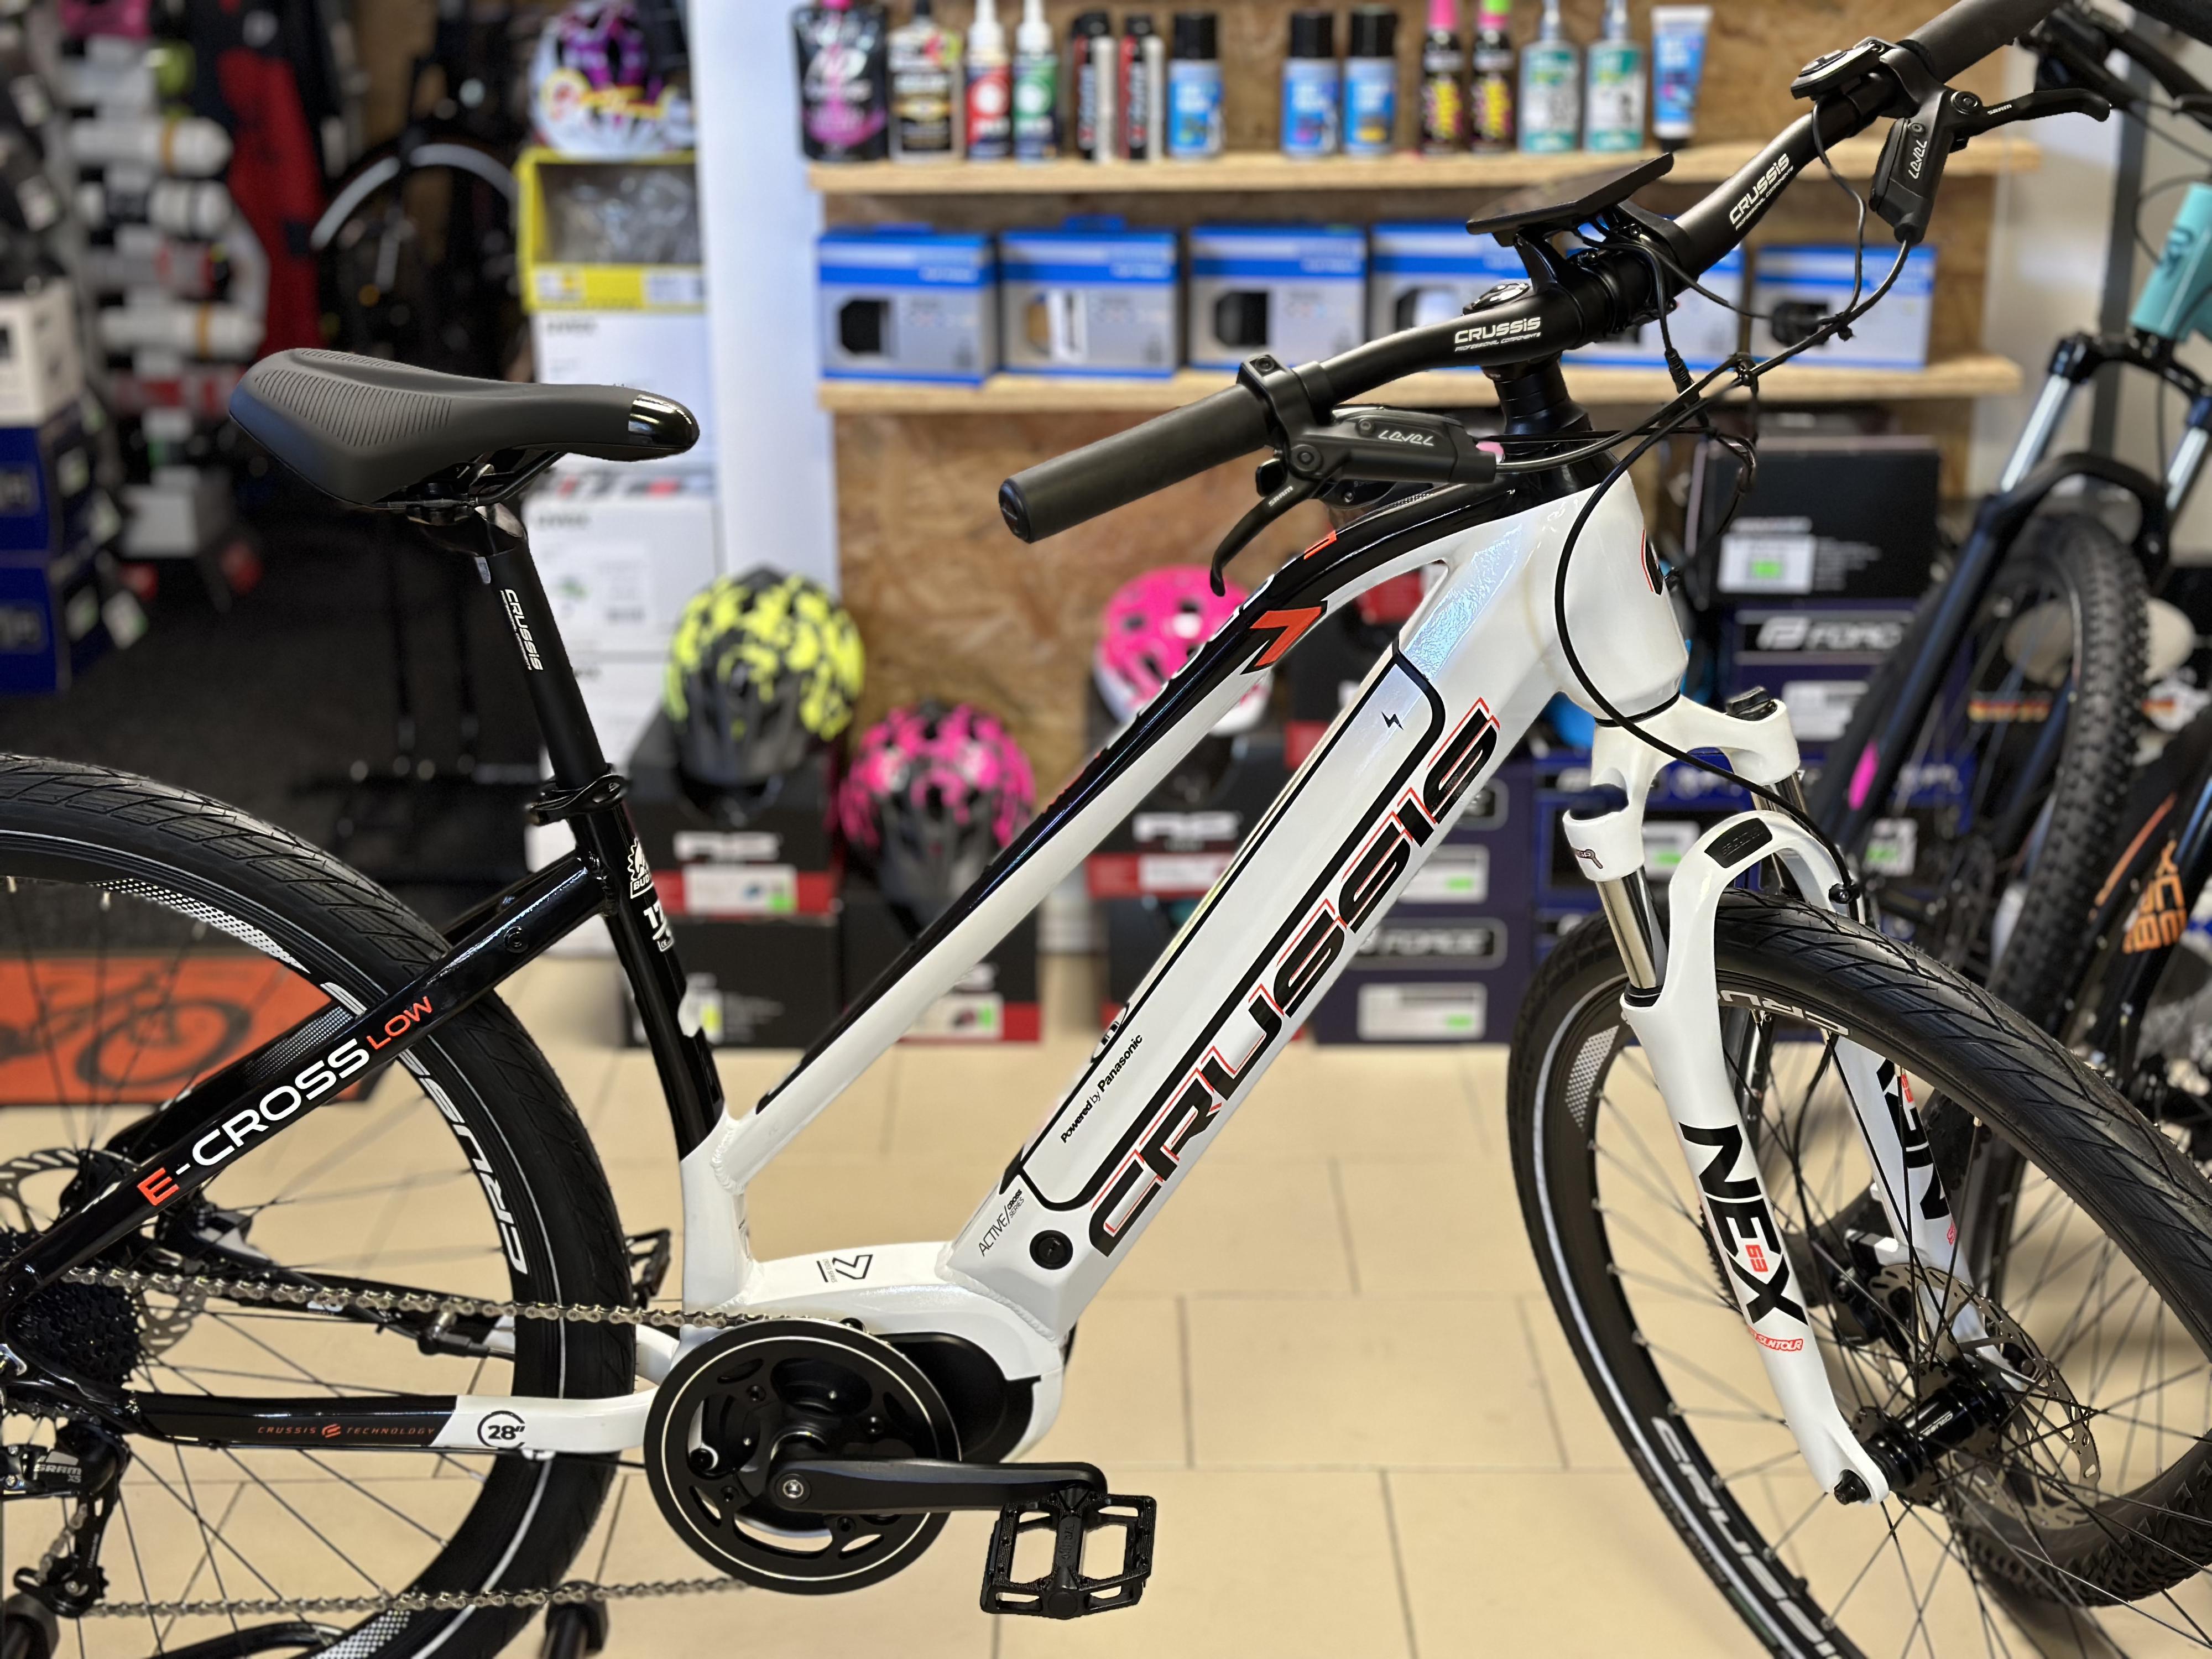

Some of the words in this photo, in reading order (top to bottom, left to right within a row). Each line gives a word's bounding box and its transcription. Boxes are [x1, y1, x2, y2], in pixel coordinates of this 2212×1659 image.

[1986, 103, 2013, 116] SRAM
[1268, 485, 1294, 508] SRAM
[366, 995, 433, 1050] LOW
[1060, 1099, 1093, 1144] Powered
[1089, 1091, 1101, 1104] by
[1097, 1035, 1143, 1093] Panasonic
[1678, 1121, 1809, 1327] NEX
[257, 1426, 317, 1434] CRUSSIS
[346, 1427, 436, 1436] TECHNOLOGY
[33, 1464, 82, 1476] SRAM
